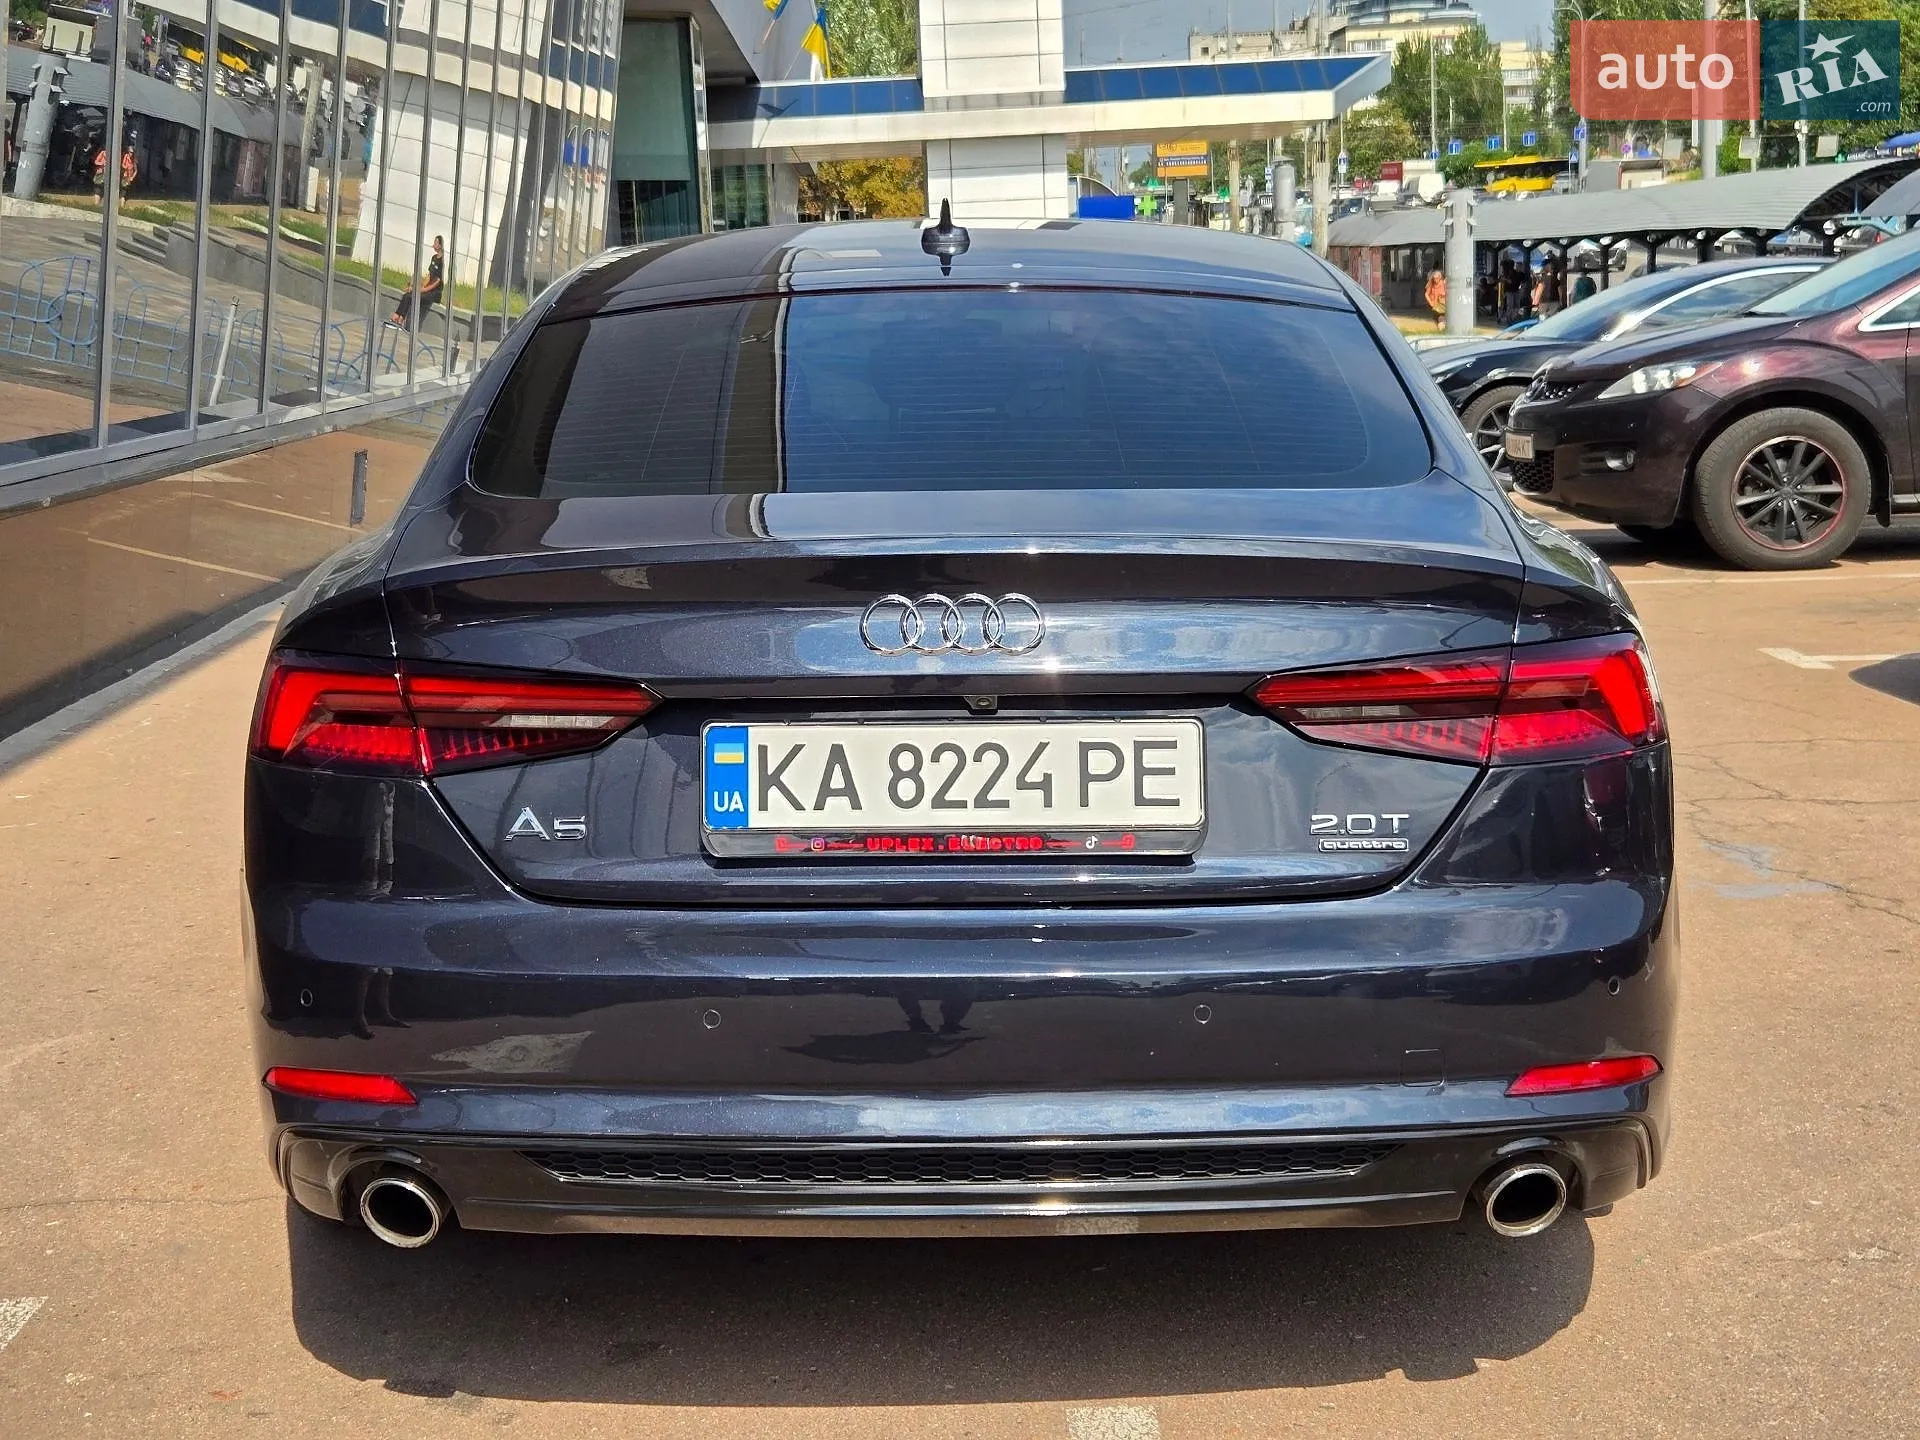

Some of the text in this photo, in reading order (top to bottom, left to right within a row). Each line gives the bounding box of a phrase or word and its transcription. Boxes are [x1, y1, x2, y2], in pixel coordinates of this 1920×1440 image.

[758, 740, 1180, 811] KA 8224 PE
[713, 790, 745, 812] UA
[503, 806, 587, 841] A5
[1323, 840, 1406, 849] quattro
